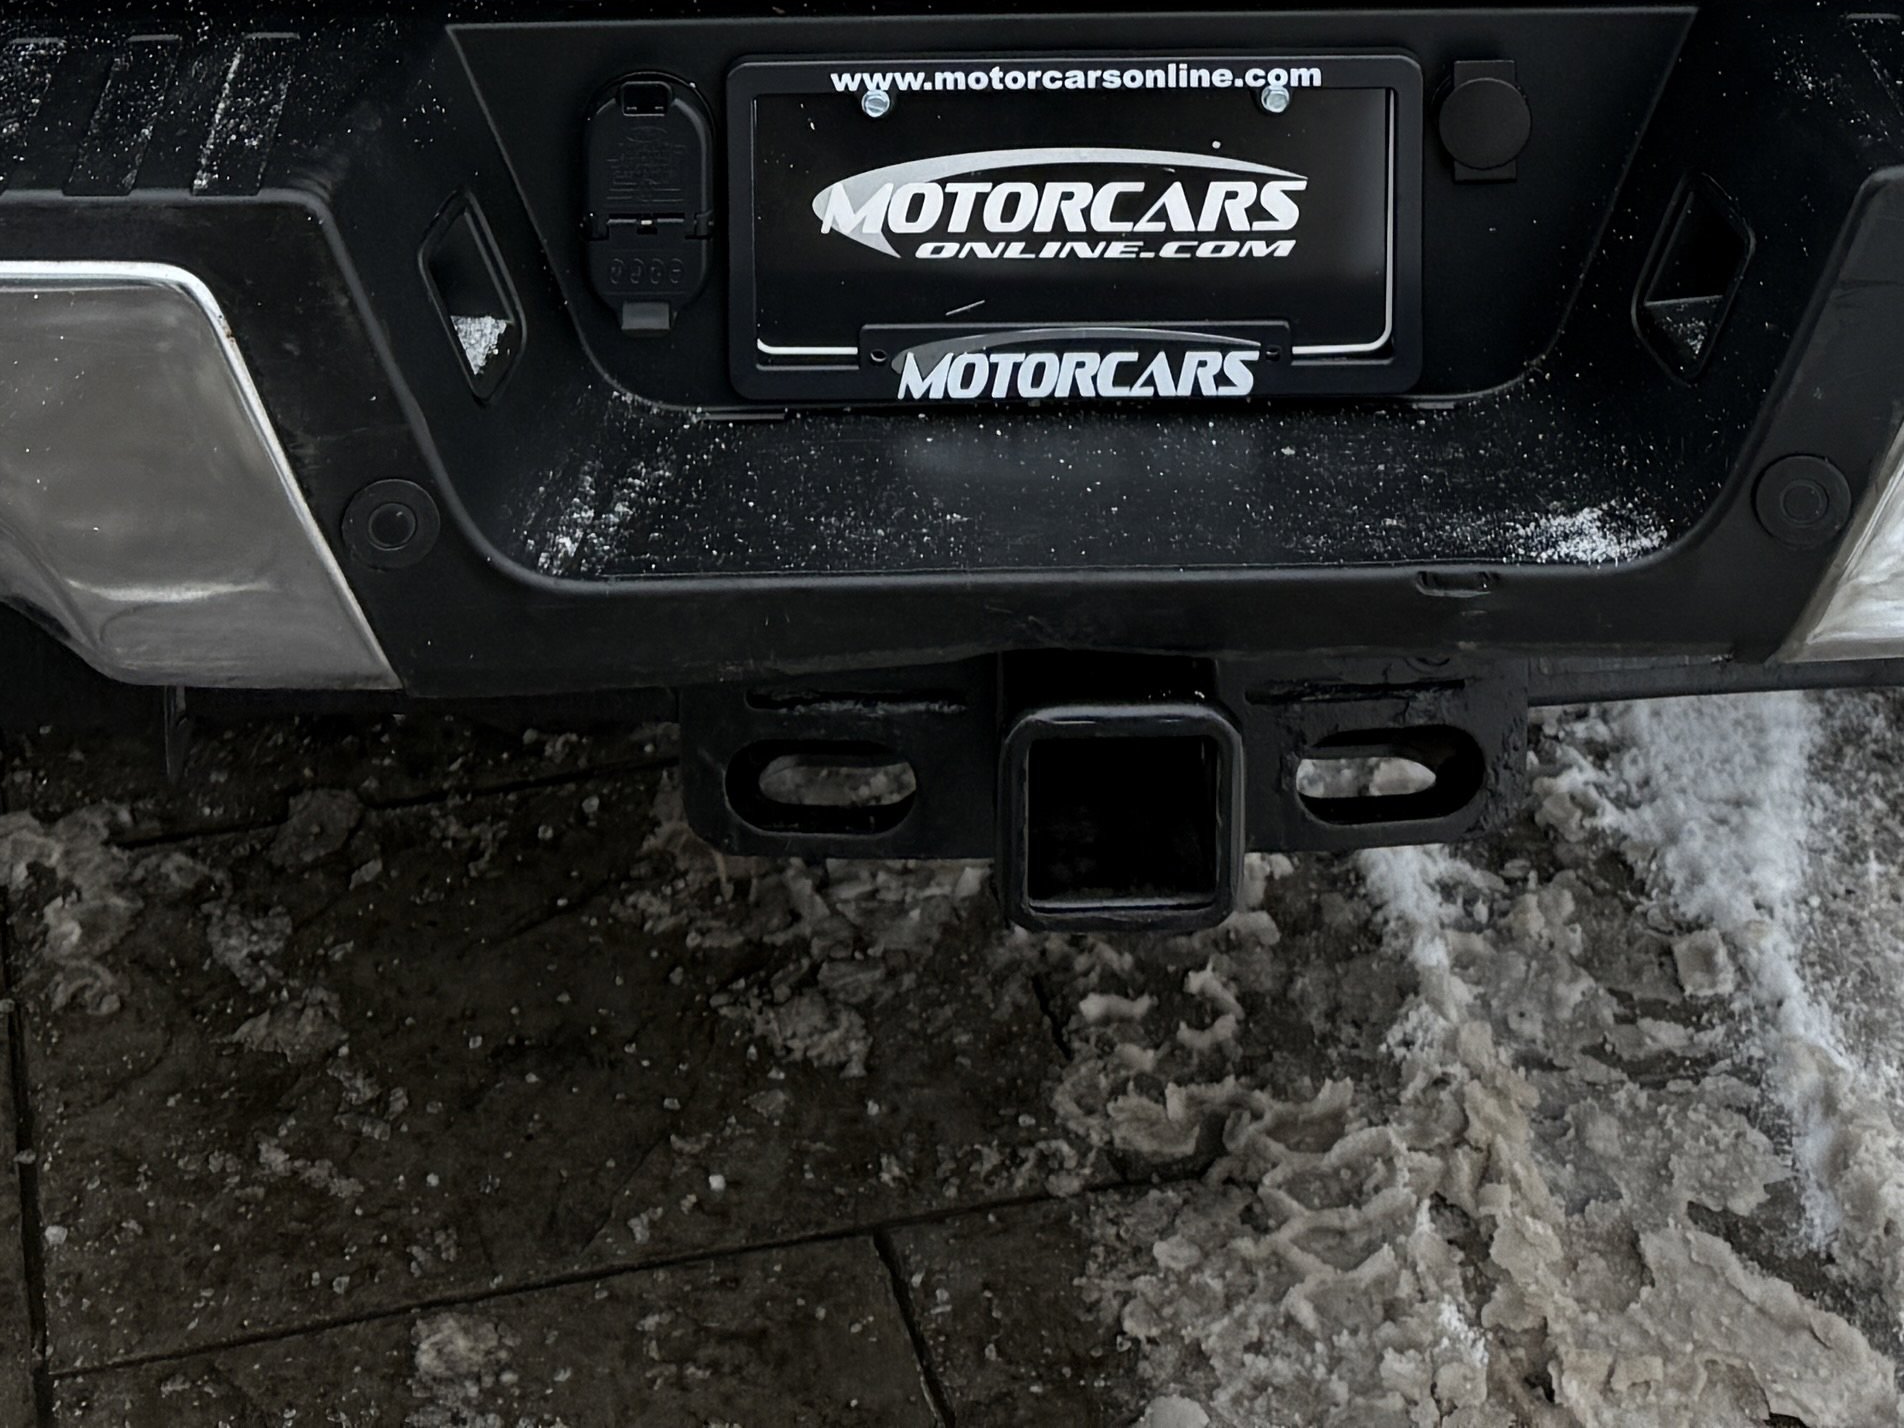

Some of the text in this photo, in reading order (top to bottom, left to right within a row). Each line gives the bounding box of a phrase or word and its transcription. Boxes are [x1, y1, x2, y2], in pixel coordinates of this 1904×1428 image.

[830, 62, 1323, 92] www.motorcarsonline.com
[820, 180, 1308, 235] MOTORCARS
[914, 238, 1297, 260] ONLINE.COM
[896, 348, 1262, 401] MOTORCARS
